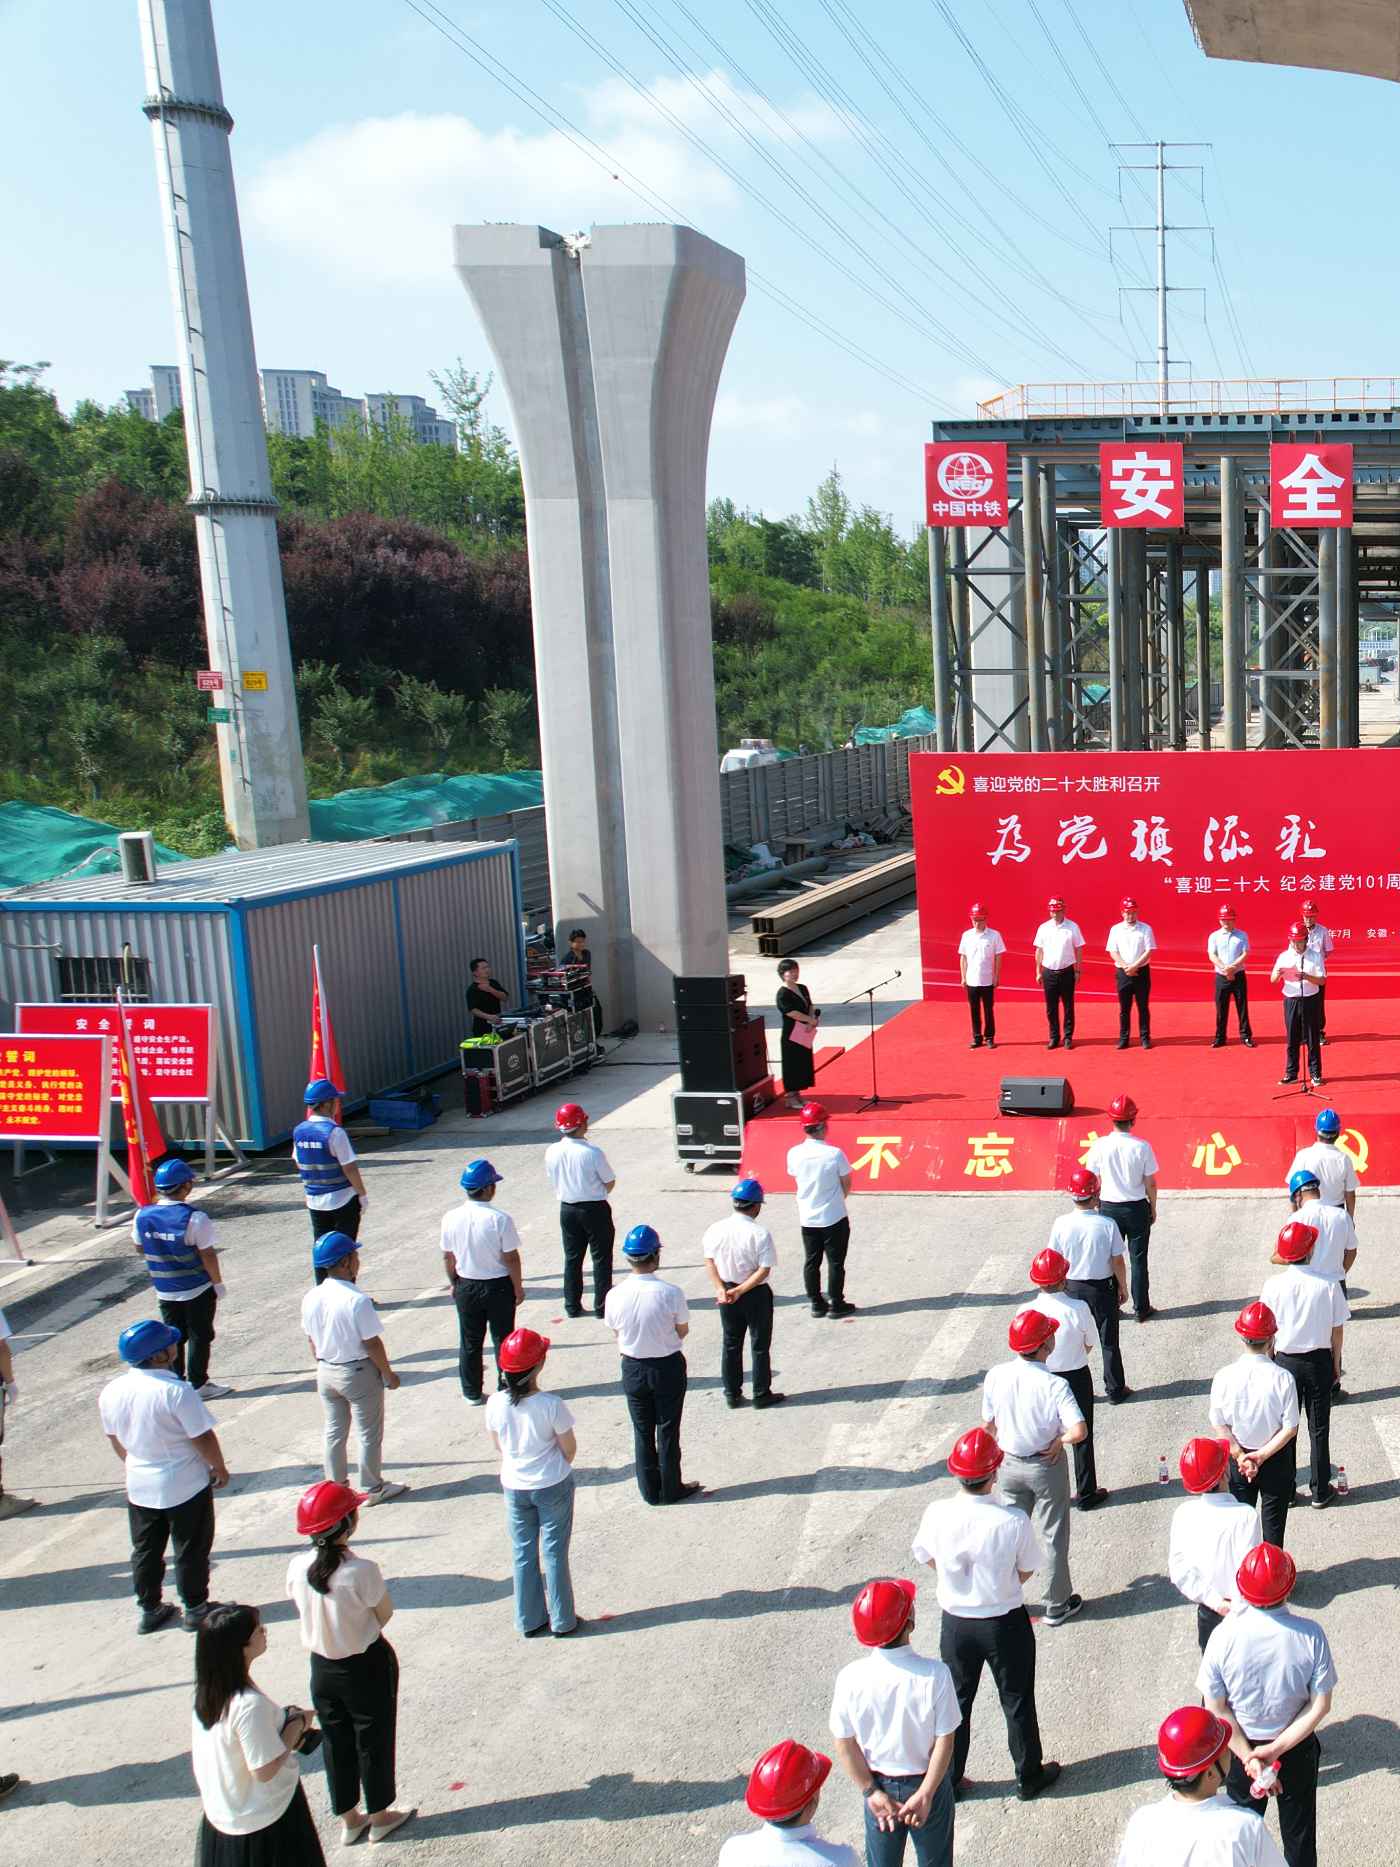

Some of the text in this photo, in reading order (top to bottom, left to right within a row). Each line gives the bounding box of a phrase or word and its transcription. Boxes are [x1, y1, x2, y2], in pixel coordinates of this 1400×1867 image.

[932, 500, 1001, 517] 中国中铁
[972, 775, 1161, 793] 喜迎党的二十大胜利召开
